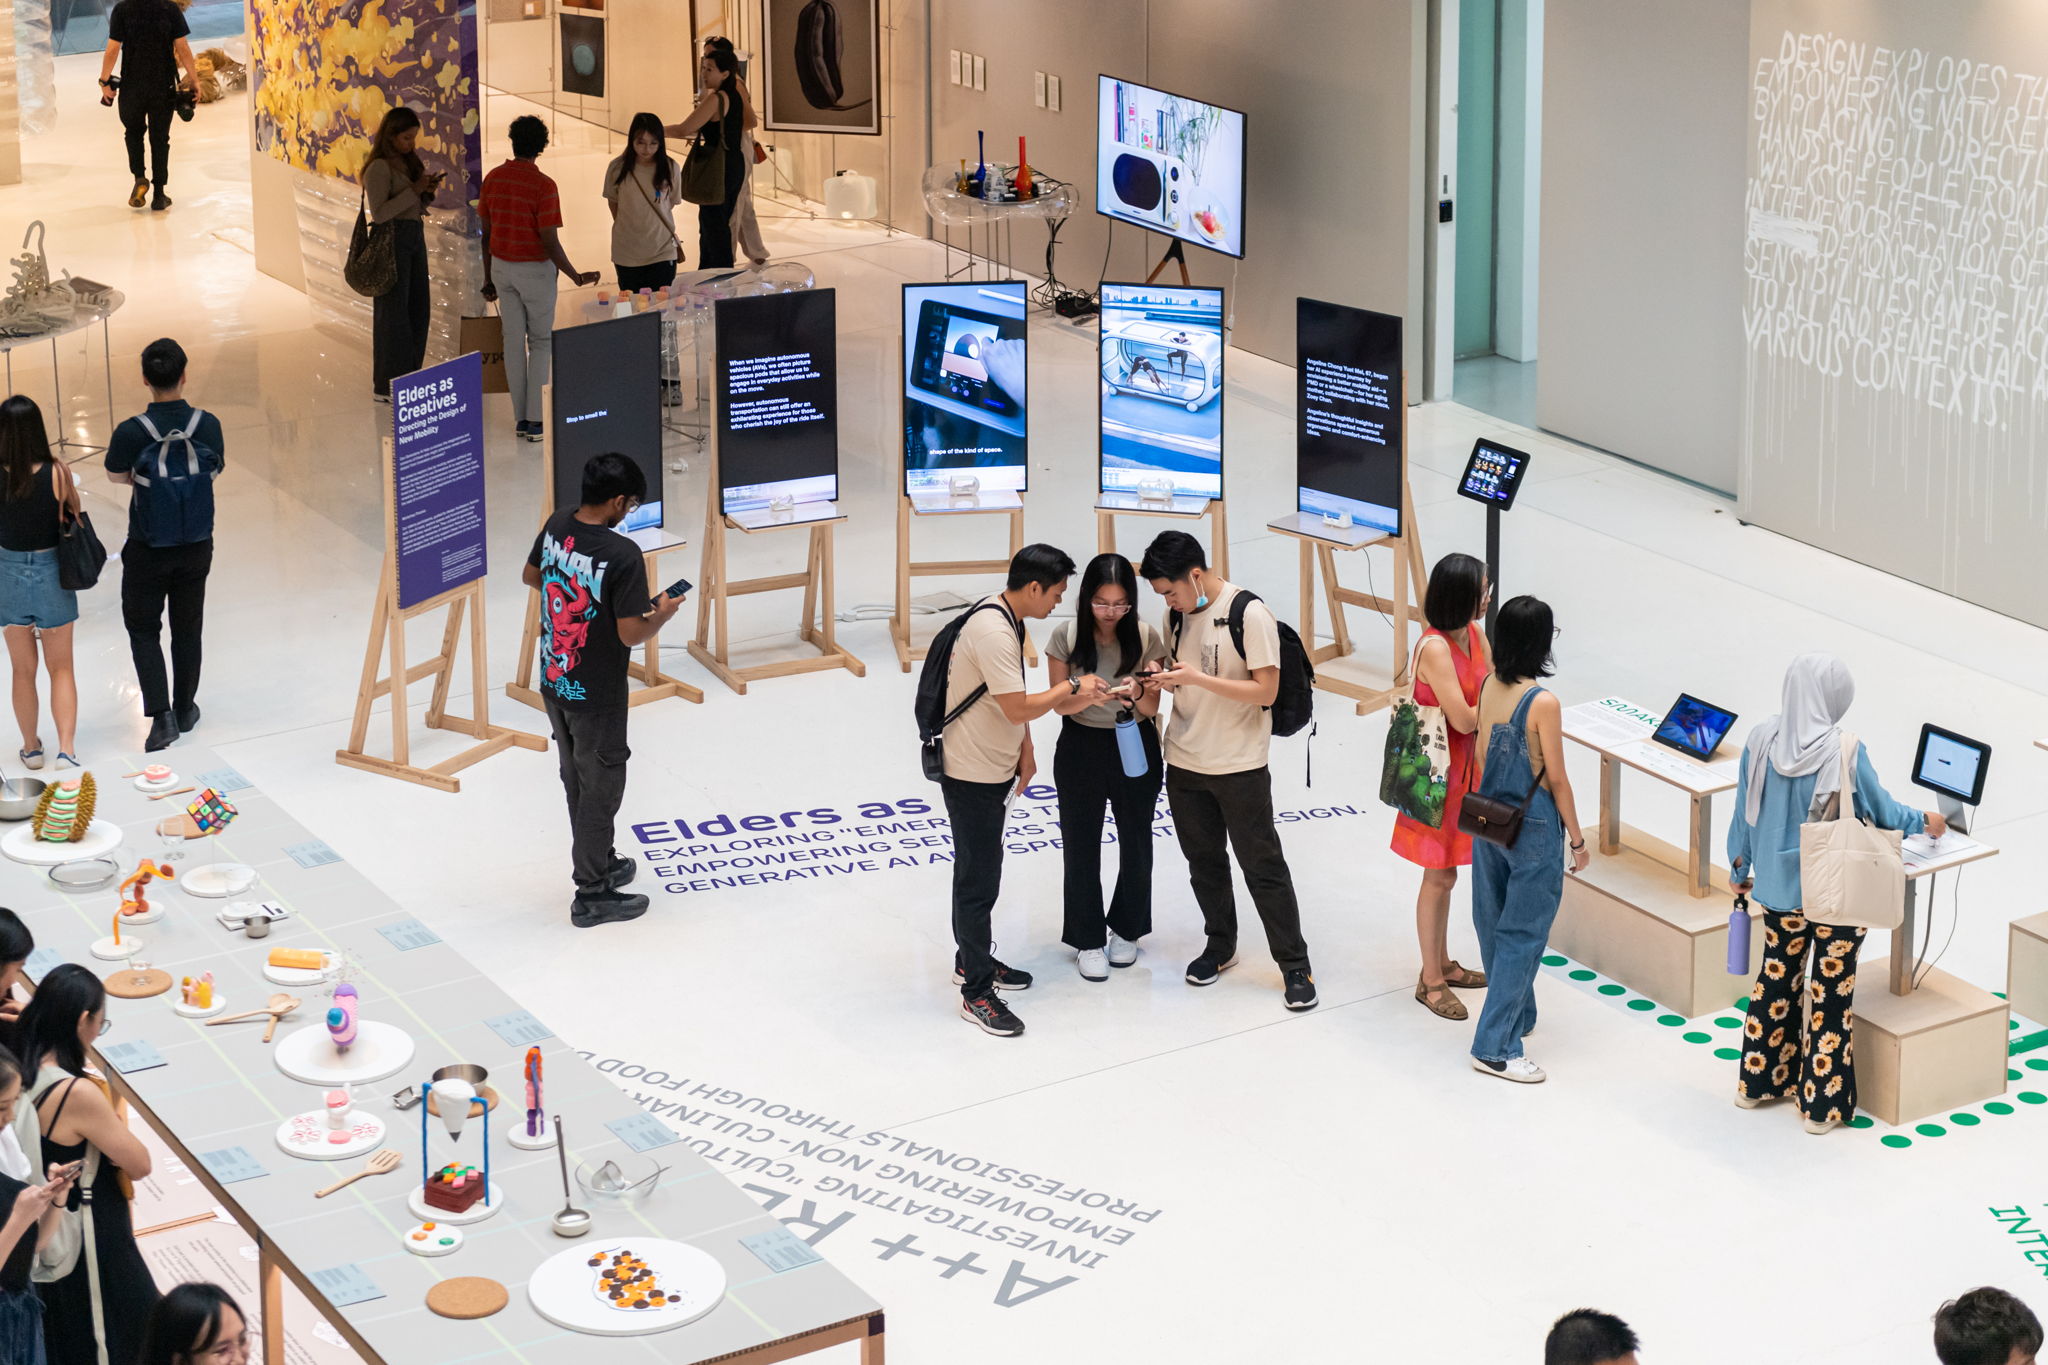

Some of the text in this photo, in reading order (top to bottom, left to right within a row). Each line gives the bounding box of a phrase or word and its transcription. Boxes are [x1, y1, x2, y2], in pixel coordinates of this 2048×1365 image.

[1779, 30, 1866, 78] DESIGN
[1870, 45, 2007, 104] EXPLORES
[1754, 57, 2040, 149] EMPOWERING NATURE
[1754, 86, 1783, 126] BY
[1791, 93, 1896, 159] PLACING
[1758, 118, 2037, 228] HANDS OF PEOPLE FROM
[1760, 152, 1833, 200] WALKS
[1836, 170, 1868, 202] OF
[1942, 199, 1996, 244] THIS
[1744, 177, 2048, 289] IN THE DEMOCRATISATION OF
[1744, 238, 2009, 348] SENSIBILITIES CAN BE
[1822, 225, 2003, 311] DEMONSTRATES
[755, 356, 776, 364] imagine
[777, 352, 810, 361] autonomous
[1750, 274, 1778, 312] TO
[1784, 282, 1823, 328] ALL
[1829, 301, 1871, 339] AND
[1878, 310, 2025, 392] BENEFICIAL
[398, 377, 453, 407] Elders as
[730, 366, 752, 374] vehicles
[1742, 303, 2007, 432] VARIOUS CONTEXTS.
[398, 392, 457, 422] Creatives
[398, 403, 467, 434] Directing the Design of
[756, 398, 789, 406] autonomous
[398, 425, 439, 446] New Mobility
[631, 798, 932, 845] Elders as
[643, 829, 835, 862] EXPLORING
[653, 841, 893, 879] EMPOWERING
[663, 859, 880, 895] GENERATIVE
[888, 855, 920, 870] AI
[596, 1058, 691, 1091] FOOD
[688, 1083, 856, 1139] THROUGH
[676, 1131, 804, 1184] "CULTU
[859, 1131, 1163, 1224] PROFESSIONALS
[814, 1175, 1109, 1269] INVESTIGATING
[875, 1163, 1136, 1246] EMPOWERING
